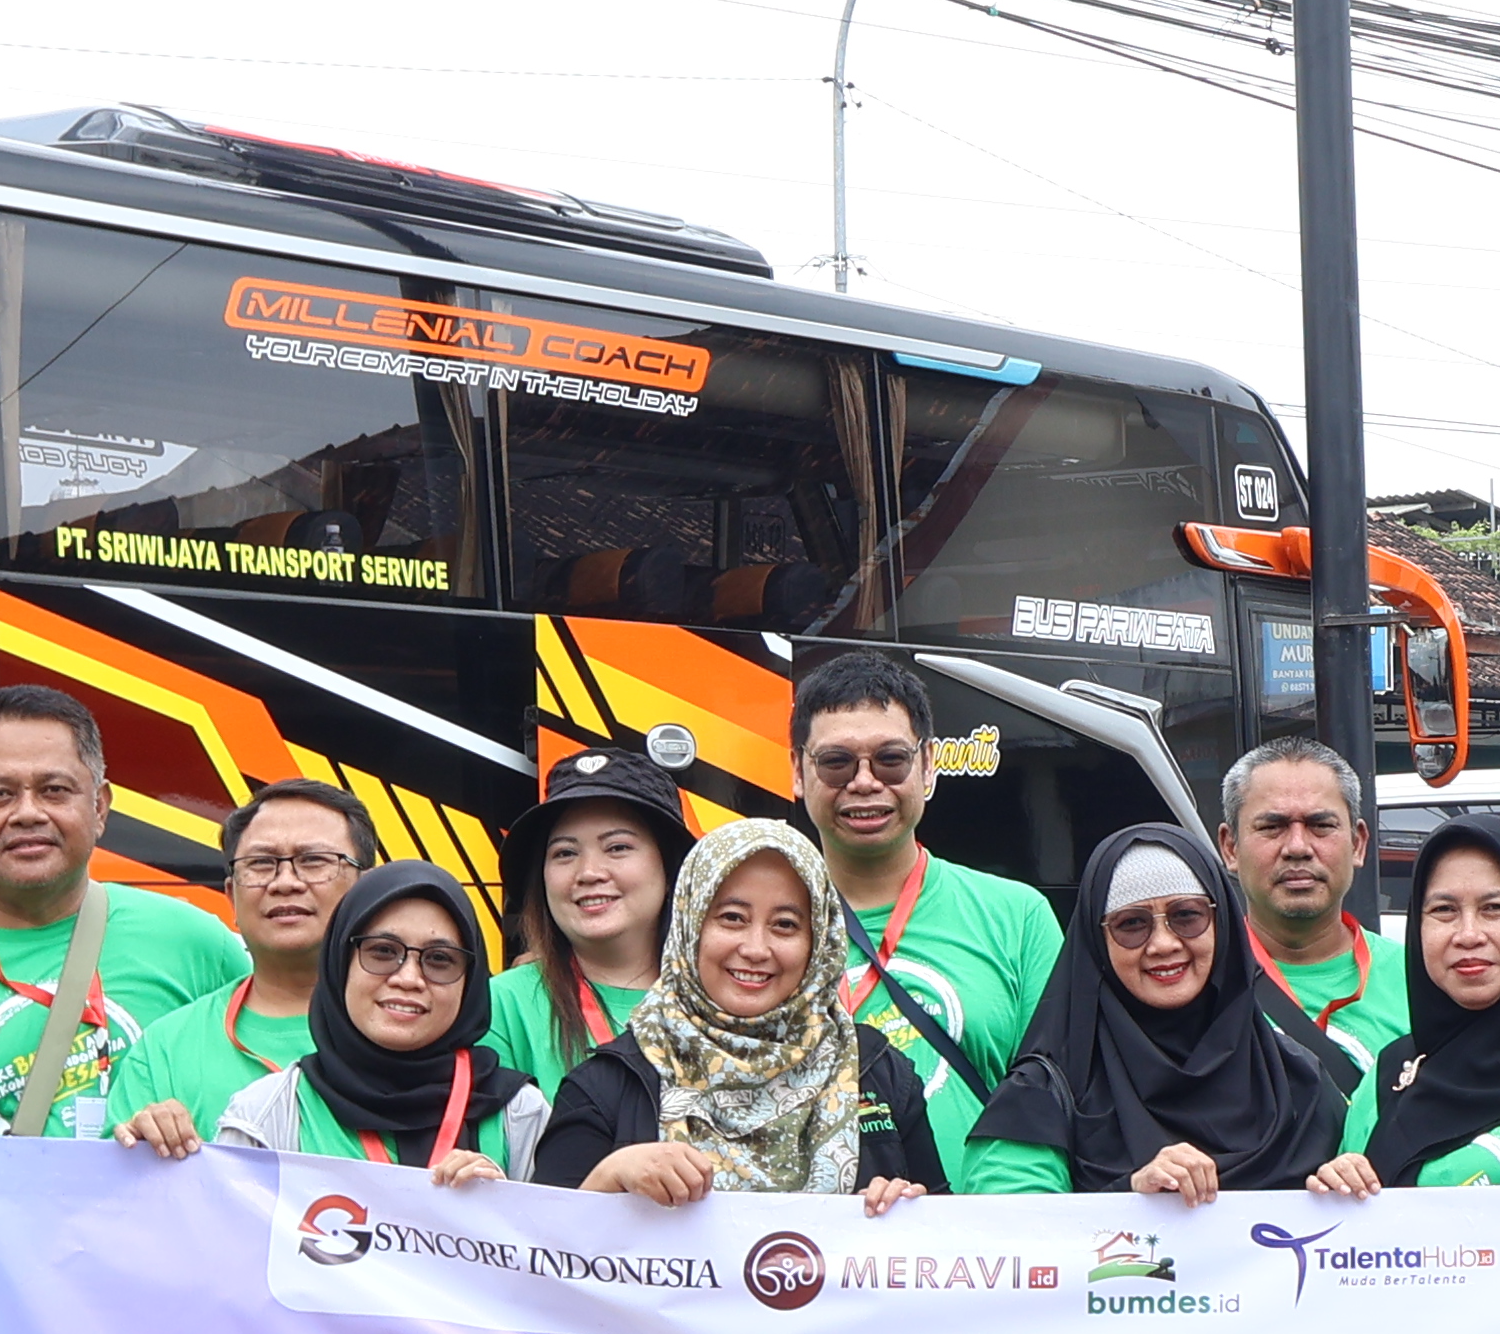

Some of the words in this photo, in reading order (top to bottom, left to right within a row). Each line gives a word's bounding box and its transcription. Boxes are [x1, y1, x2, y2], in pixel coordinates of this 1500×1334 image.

[245, 291, 517, 352] MILLENIAL
[543, 334, 697, 381] COACH
[246, 334, 338, 368] YOUR
[489, 365, 519, 394] IN
[521, 371, 582, 401] THE
[581, 382, 699, 418] HOLIDAY
[1239, 475, 1252, 508] ST
[1253, 476, 1275, 511] 024
[57, 525, 92, 560] PT.
[97, 529, 222, 572] SRIWIJAYA
[225, 542, 355, 584] TRANSPORT
[360, 554, 450, 590] SERVICE
[1012, 595, 1076, 642] BUS
[1075, 601, 1216, 655] PARIWISATA
[1280, 644, 1314, 663] MUR
[374, 1224, 520, 1271] SYNCORE
[527, 1245, 721, 1290] INDONESIA
[1338, 1273, 1378, 1287] Muda
[1383, 1273, 1467, 1287] BerTalenta
[1087, 1289, 1241, 1316] bumdes.id
